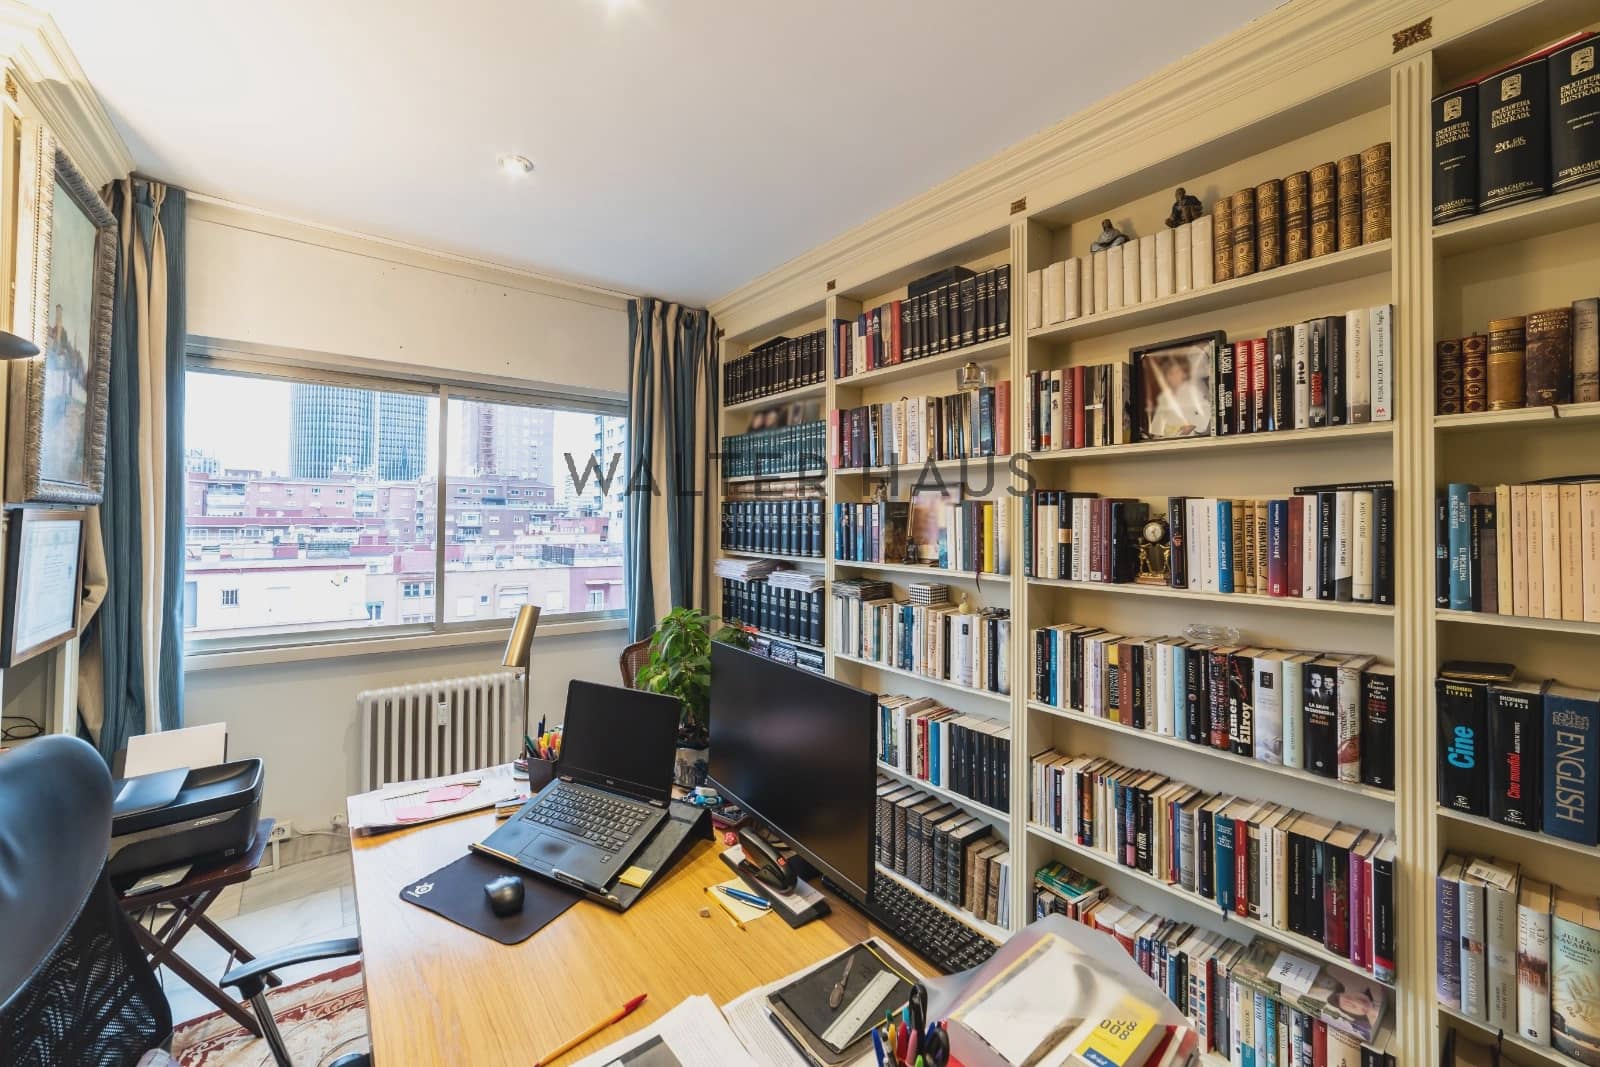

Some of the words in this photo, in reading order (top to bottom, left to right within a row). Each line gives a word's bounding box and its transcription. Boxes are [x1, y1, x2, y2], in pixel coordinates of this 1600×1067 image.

[1492, 106, 1531, 122] UNIVERSAL
[1492, 112, 1530, 128] ILUSTRADA
[1369, 692, 1387, 700] Prada
[1229, 698, 1240, 743] James
[1240, 702, 1253, 745] Ellroy
[1448, 725, 1476, 769] Cine
[1505, 752, 1521, 783] mundial
[1556, 730, 1586, 824] ENGLISH
[1507, 782, 1520, 799] Cine
[1442, 884, 1453, 908] EYRE
[1442, 909, 1453, 935] PILAR
[1560, 931, 1592, 947] JULIA
